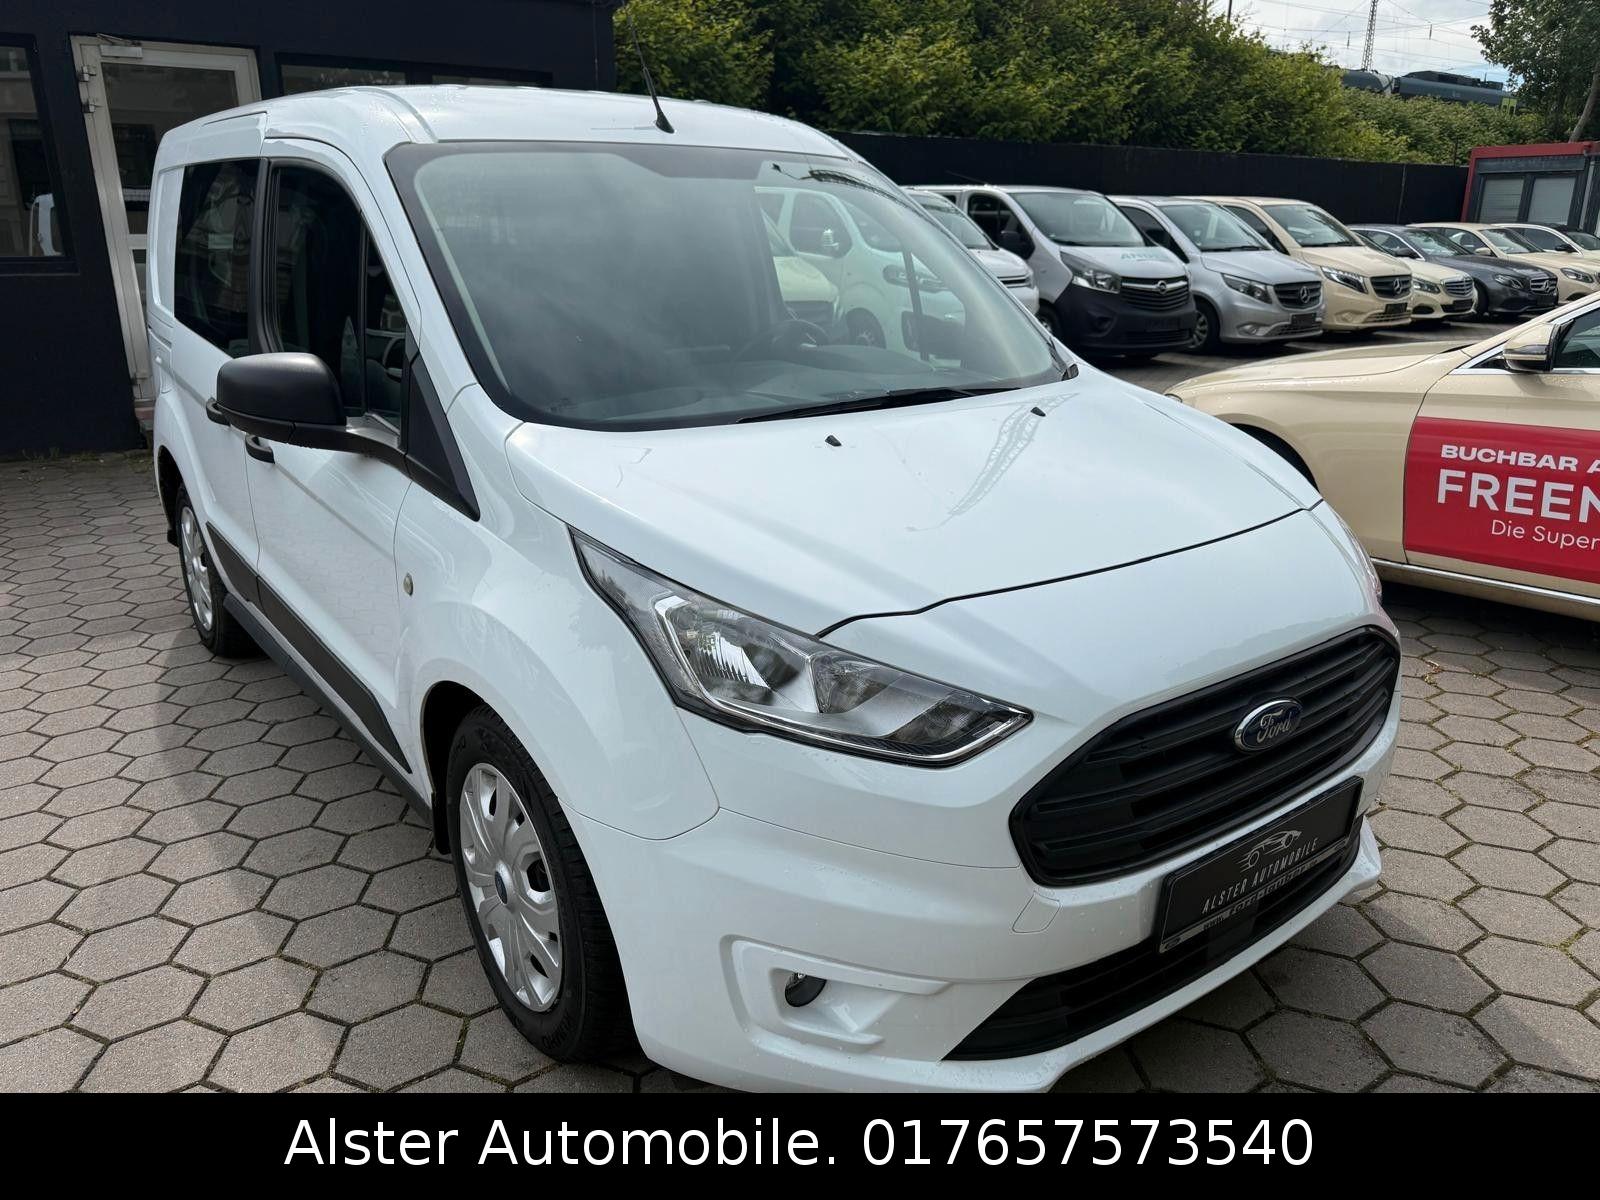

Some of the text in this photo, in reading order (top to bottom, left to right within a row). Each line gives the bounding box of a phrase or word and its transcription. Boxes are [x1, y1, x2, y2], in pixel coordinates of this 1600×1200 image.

[1441, 444, 1579, 472] BUCHBAR
[1437, 468, 1600, 523] FREEN
[1491, 519, 1600, 550] Die Super
[1256, 709, 1292, 743] Ford
[1202, 878, 1248, 914] ALSTER
[1252, 837, 1319, 887] AUTOMOBILE
